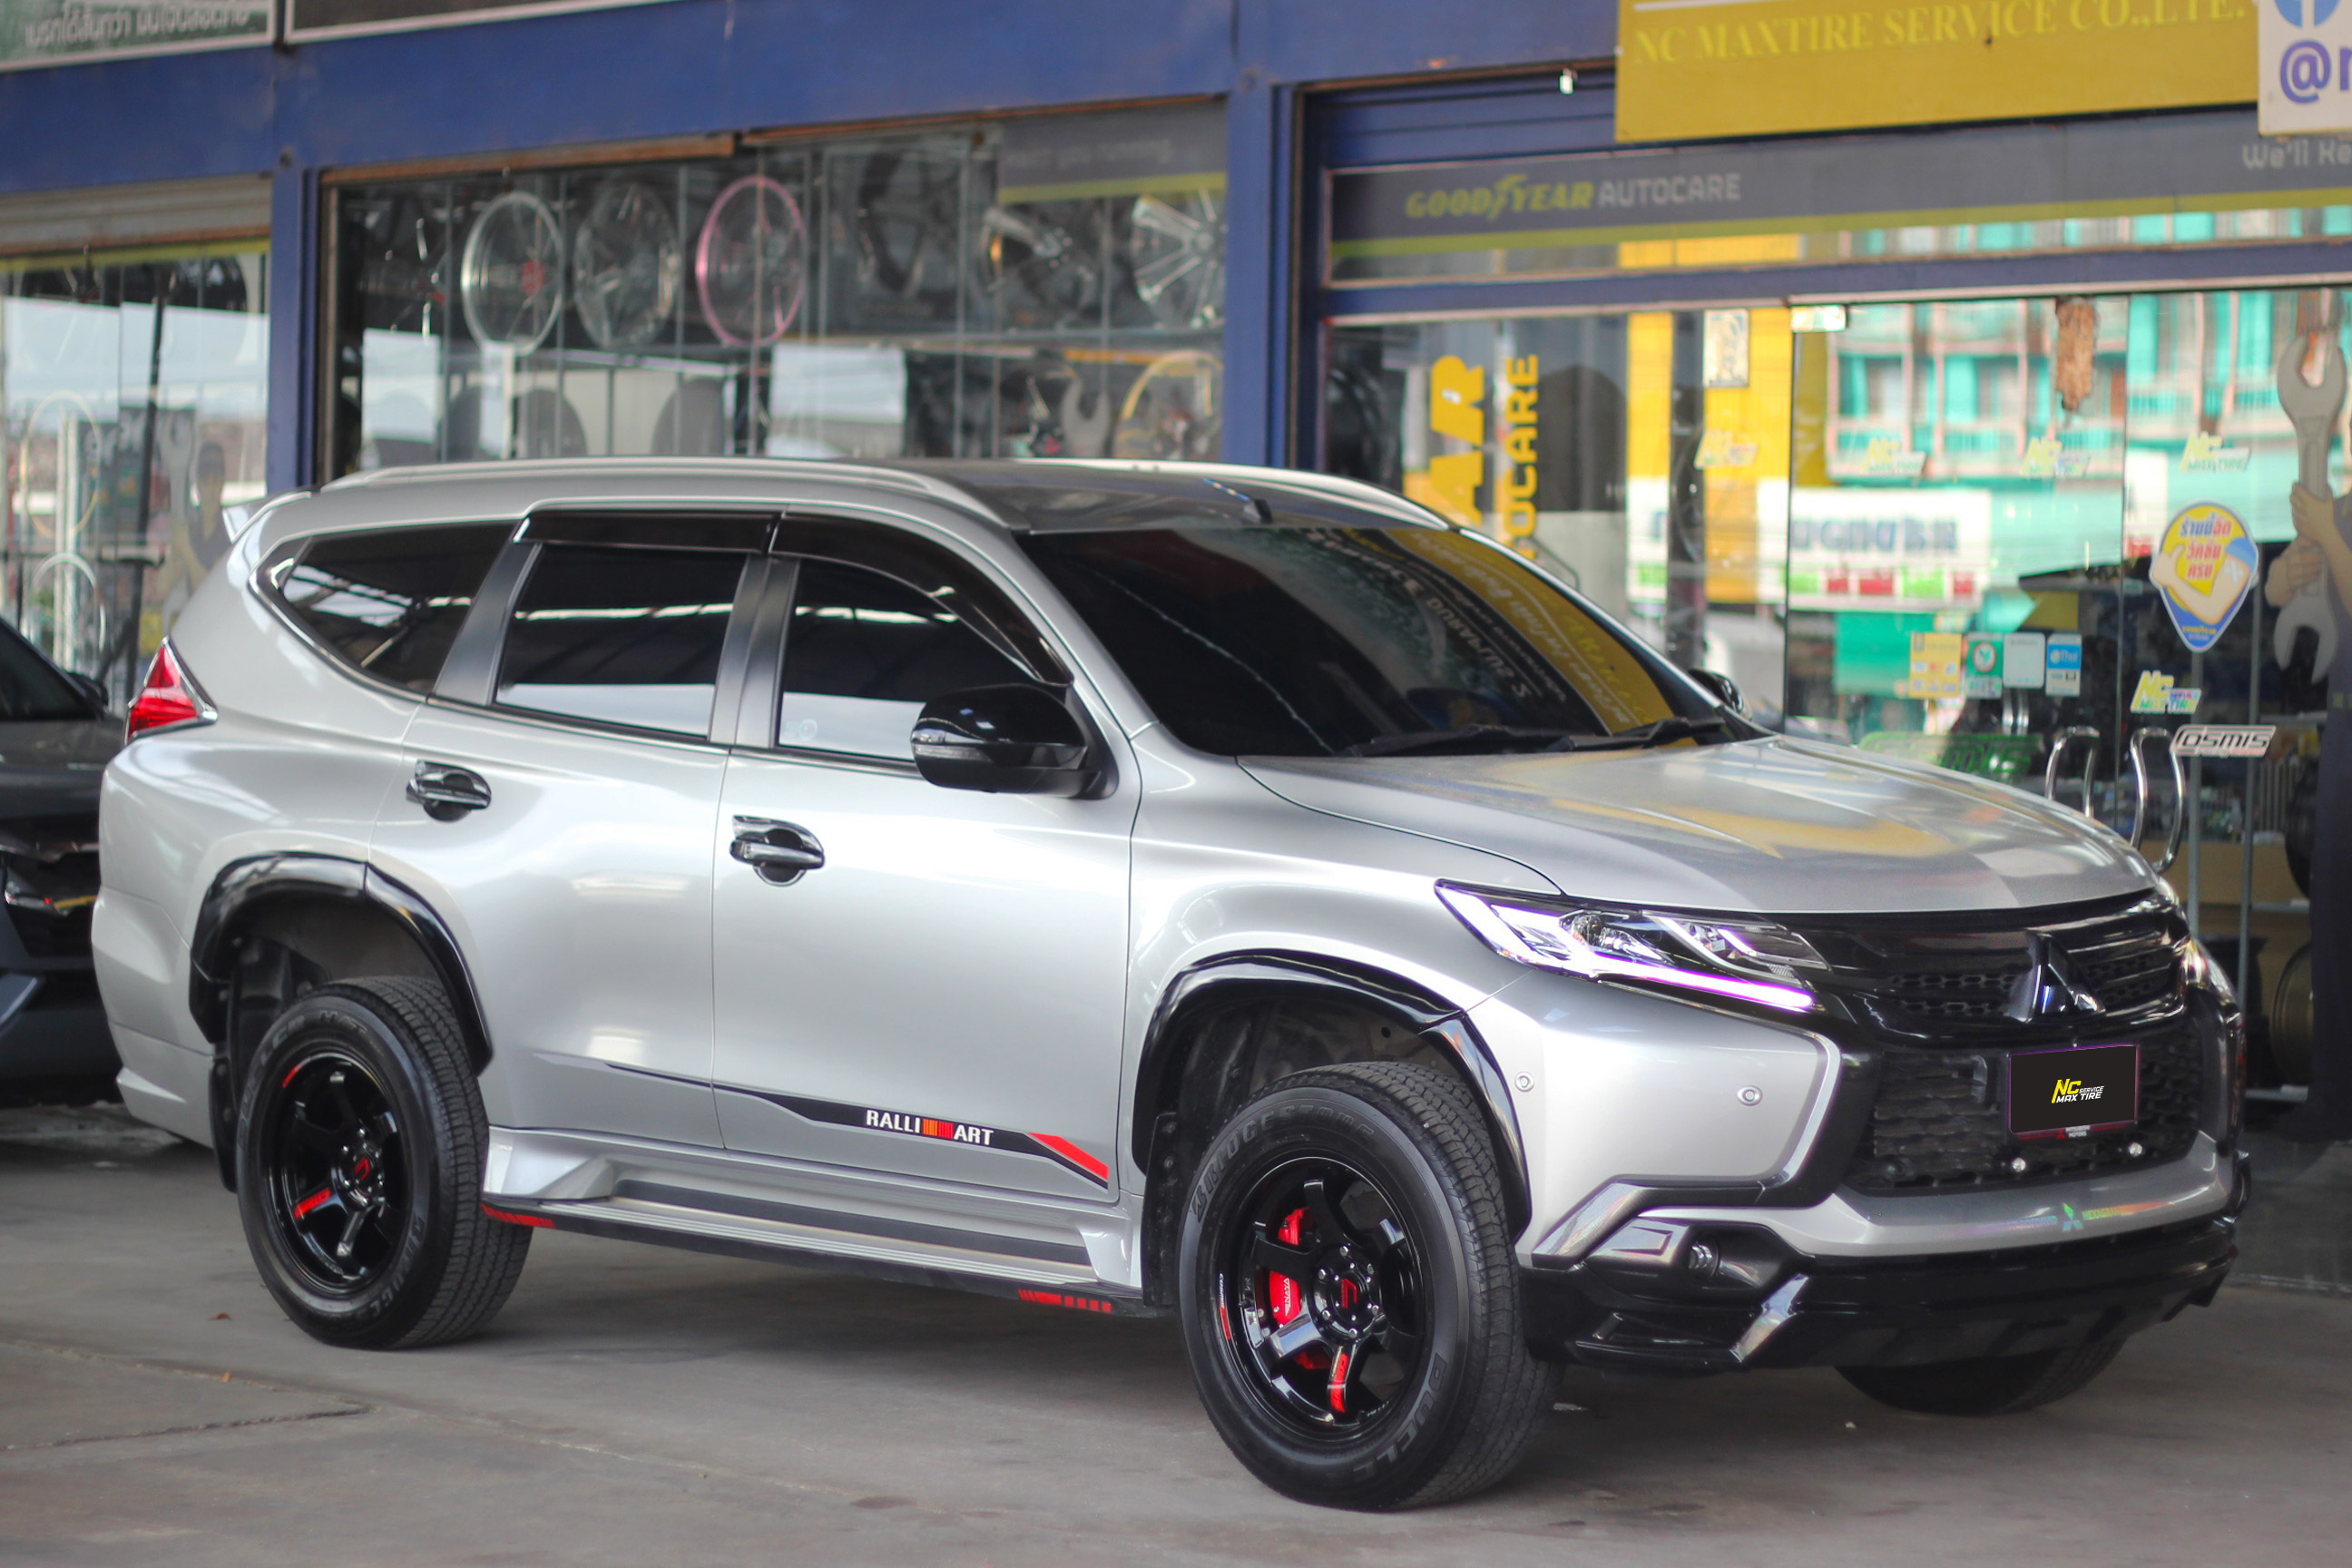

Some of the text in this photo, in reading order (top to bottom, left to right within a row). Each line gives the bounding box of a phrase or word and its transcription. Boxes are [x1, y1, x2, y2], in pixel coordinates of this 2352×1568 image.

[1634, 27, 1686, 64] NC
[1695, 13, 1873, 59] MAXTIRE
[1883, 0, 2058, 44] SERVICE
[2241, 139, 2309, 169] We'll
[1405, 173, 1741, 220] GOODYEAR AUTOCARE
[2132, 671, 2174, 710] NC
[2052, 1078, 2105, 1103] NC SERVICE
[2055, 1091, 2103, 1103] MAX TIRE
[865, 1109, 995, 1146] RALLI ART
[1191, 1104, 1376, 1224] BRIDGESTONE
